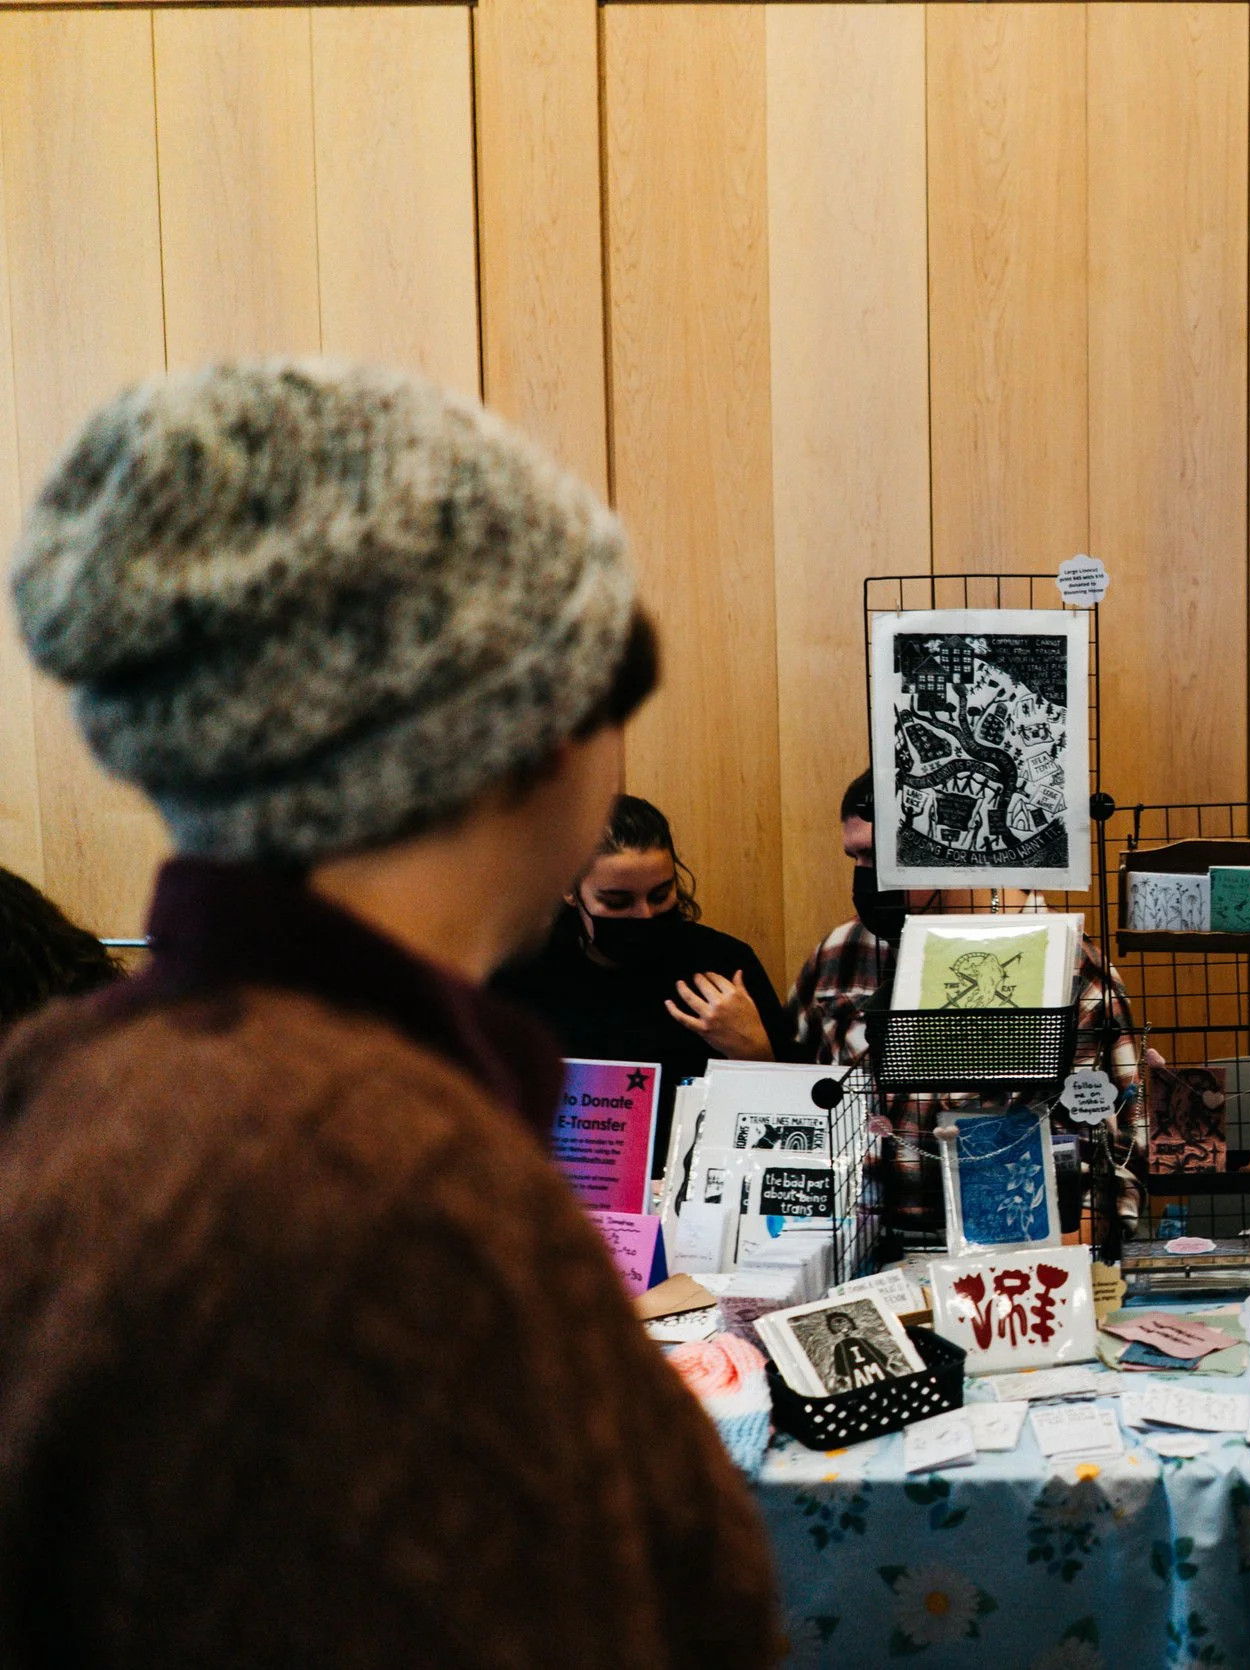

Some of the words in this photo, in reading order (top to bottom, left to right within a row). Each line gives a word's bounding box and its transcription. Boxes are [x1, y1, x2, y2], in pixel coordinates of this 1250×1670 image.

[992, 638, 1028, 646] COMMUNITY
[1035, 638, 1062, 647] CANNOT
[903, 830, 942, 856] HOUSING
[946, 848, 968, 864] FOR
[970, 852, 990, 864] ALL
[992, 850, 1018, 864] WHO
[1018, 837, 1045, 860] WANT
[1073, 1081, 1102, 1090] follow
[582, 1094, 634, 1109] Donate
[558, 1116, 627, 1132] E-Transfer
[792, 1118, 818, 1126] MATTER
[766, 1174, 782, 1186] the
[783, 1172, 805, 1188] bad
[807, 1177, 830, 1192] part
[764, 1186, 796, 1201] about
[781, 1202, 814, 1216] trans
[850, 1346, 866, 1363] I
[854, 1362, 885, 1388] AM
